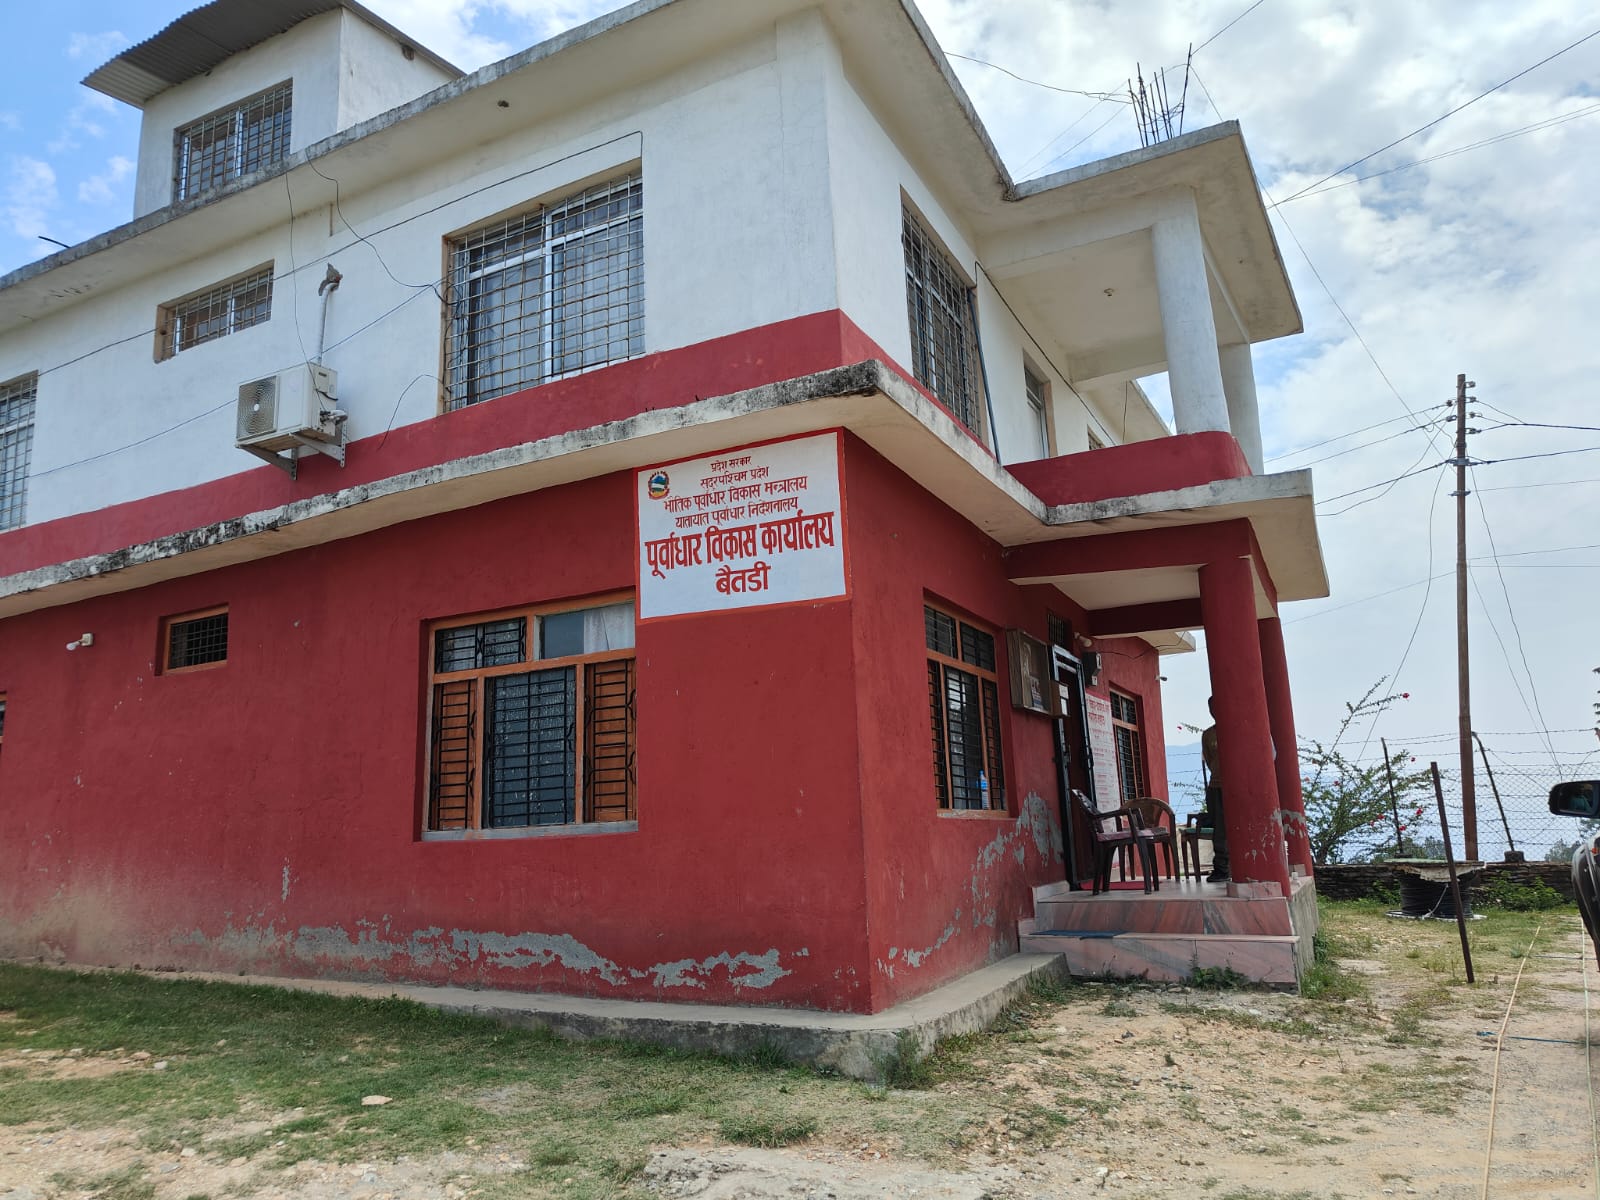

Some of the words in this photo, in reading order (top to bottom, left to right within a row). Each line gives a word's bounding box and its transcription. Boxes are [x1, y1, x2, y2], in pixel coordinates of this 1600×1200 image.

[728, 456, 752, 468] सरकार
[749, 465, 769, 480] प्रदेश
[728, 486, 761, 503] विकास
[764, 476, 808, 496] मन्त्रालय
[675, 512, 709, 529] यातायात
[644, 531, 702, 579] पूर्वाधार
[705, 525, 757, 563] विकास
[759, 509, 835, 555] कार्यालय
[715, 560, 772, 595] बैतडी
